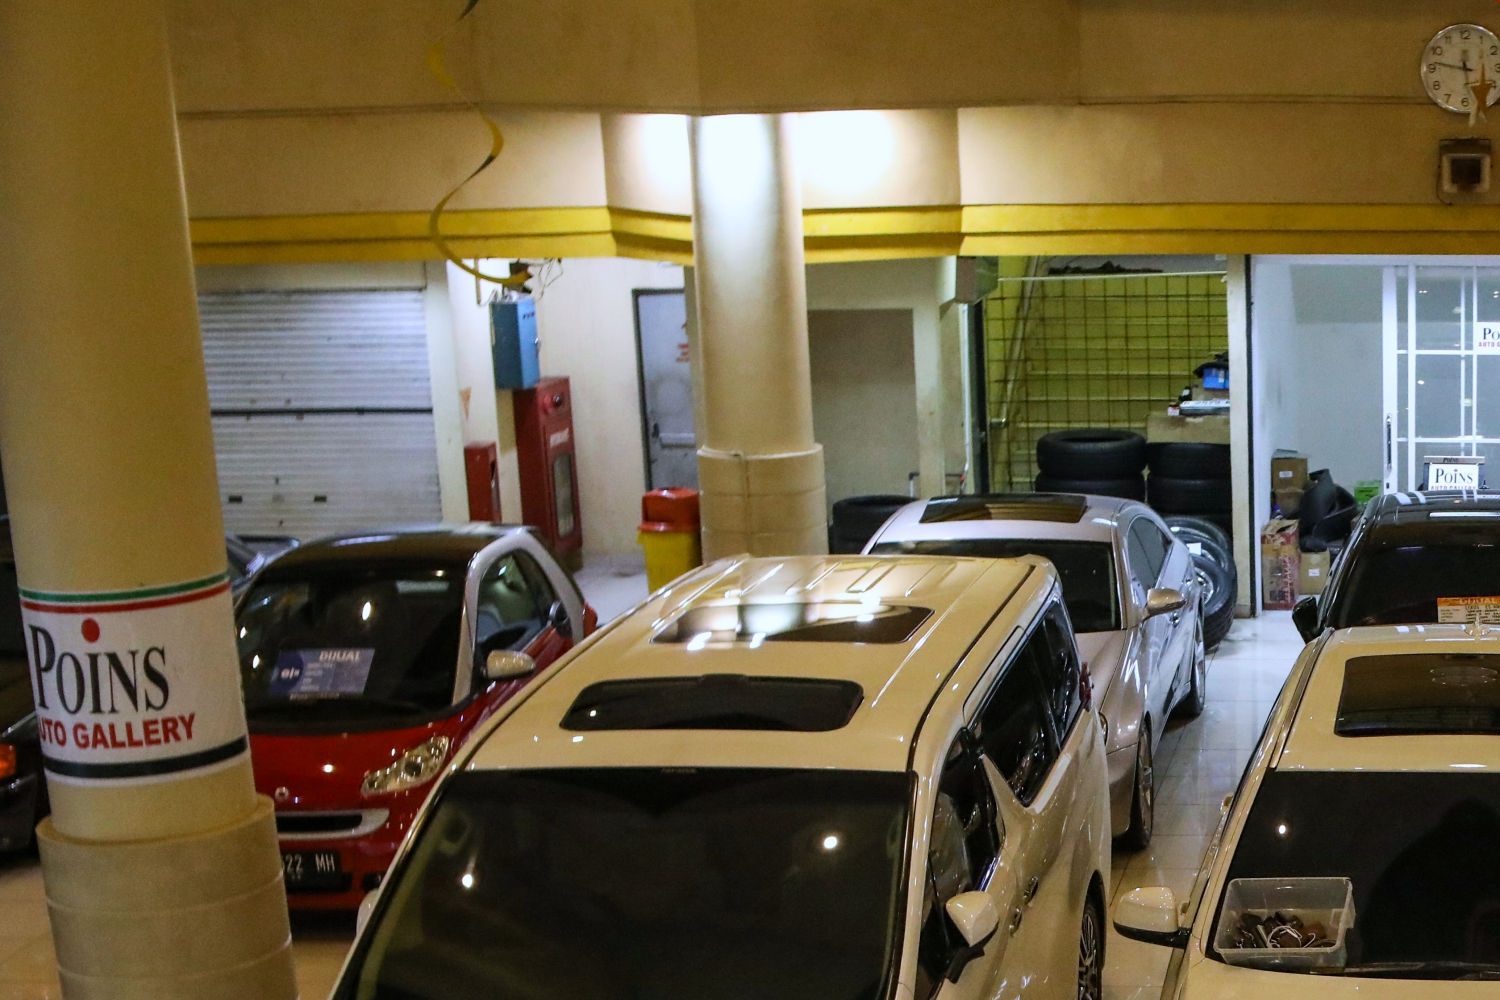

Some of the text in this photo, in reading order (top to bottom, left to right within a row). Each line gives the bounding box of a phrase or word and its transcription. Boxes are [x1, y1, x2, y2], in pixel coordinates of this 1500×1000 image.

[1460, 30, 1471, 40] 12
[1490, 45, 1499, 56] 2
[1428, 63, 1437, 73] 9
[73, 713, 195, 749] GALLERY
